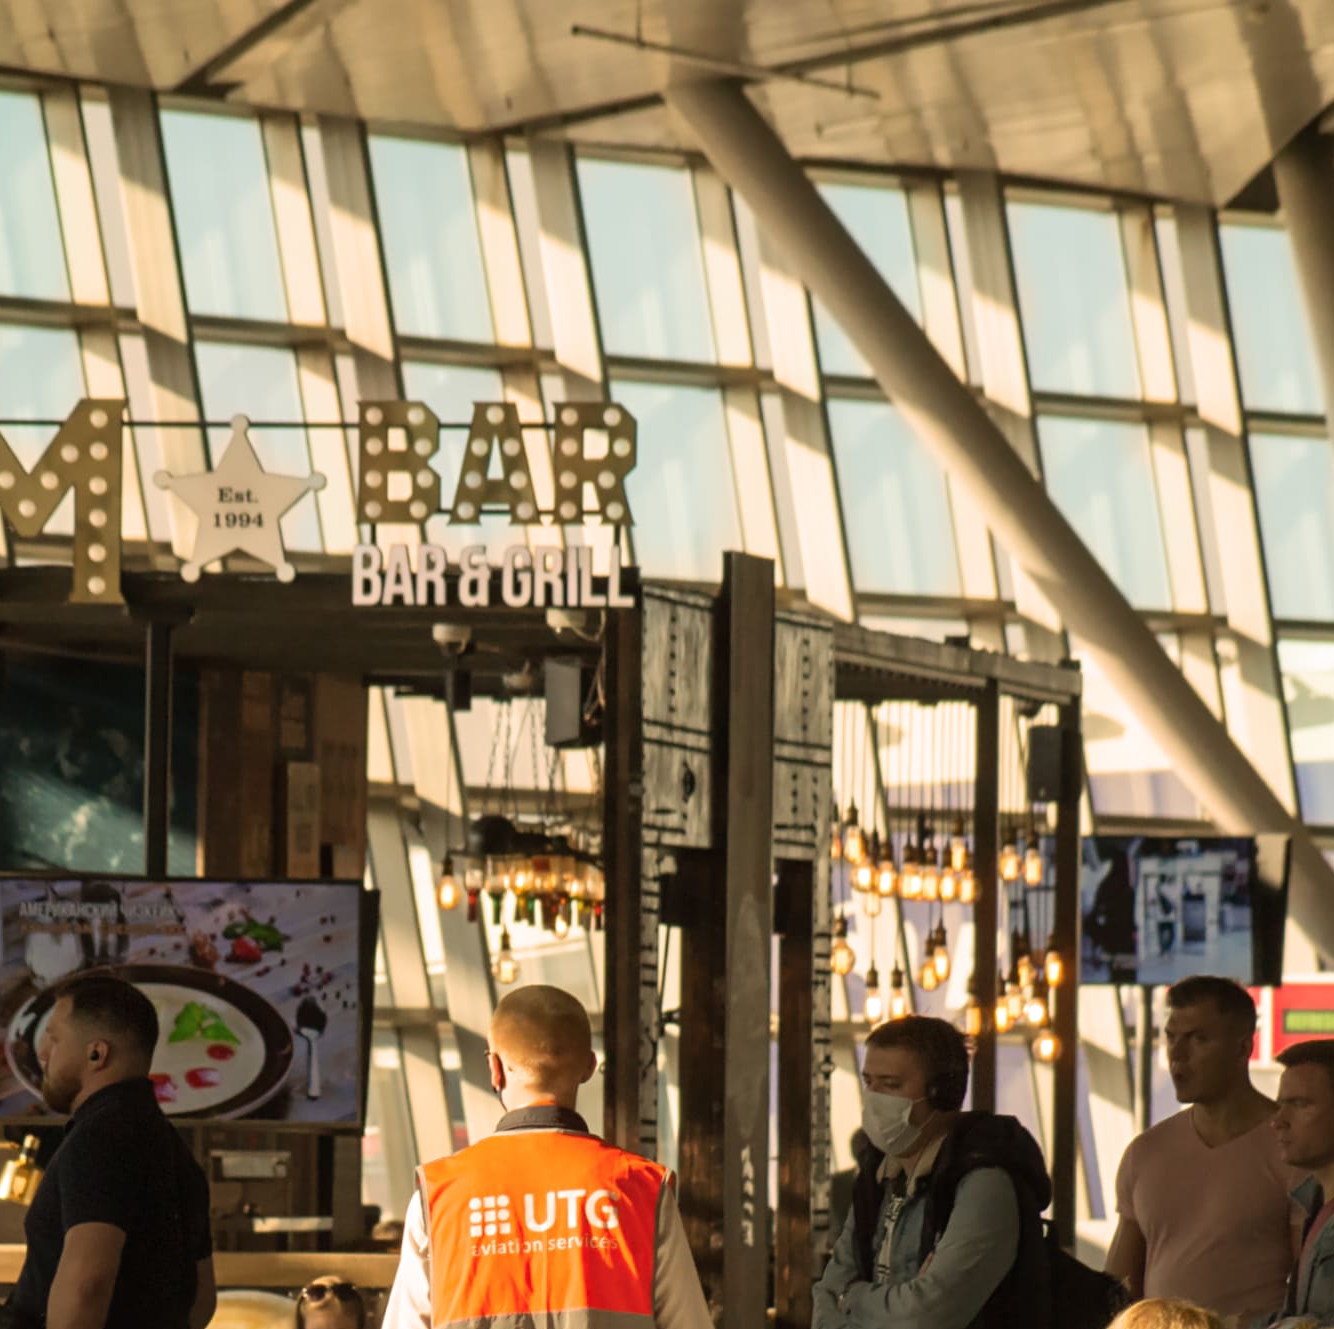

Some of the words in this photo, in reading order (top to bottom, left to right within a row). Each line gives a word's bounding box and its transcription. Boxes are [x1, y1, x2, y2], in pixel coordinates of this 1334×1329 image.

[356, 400, 637, 526] BAR
[218, 486, 260, 504] Est.
[214, 512, 264, 529] 1994
[352, 544, 447, 608] BAR
[458, 545, 491, 608] &
[501, 545, 636, 609] GRILL
[524, 1189, 619, 1232] UTG
[472, 1238, 543, 1257] aviation
[548, 1232, 618, 1251] services
